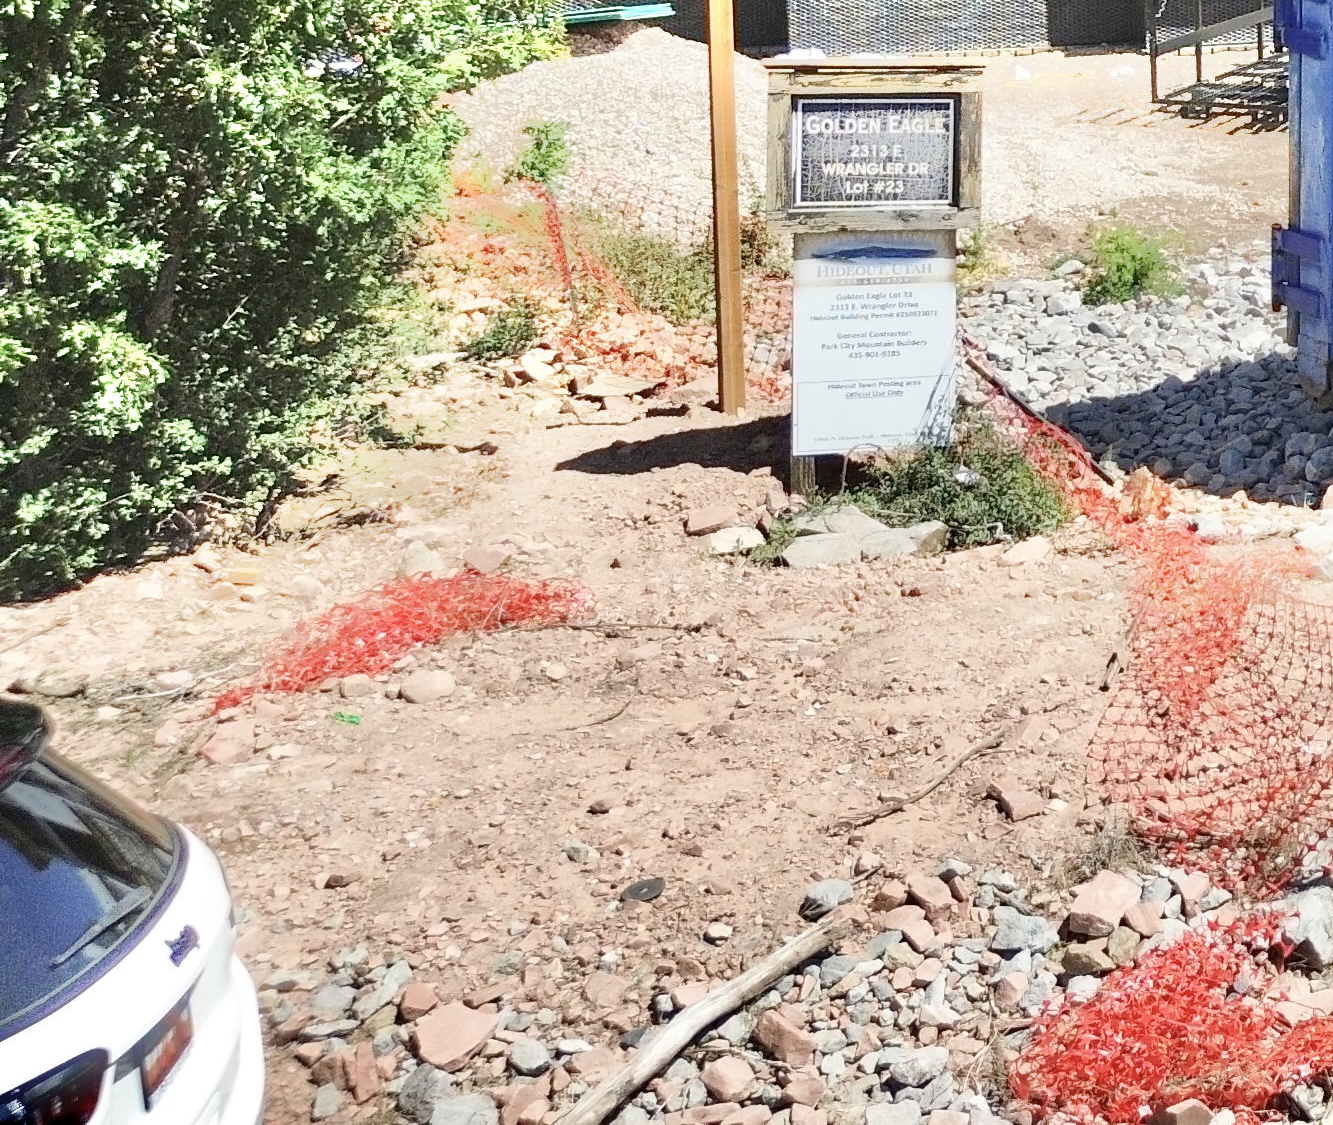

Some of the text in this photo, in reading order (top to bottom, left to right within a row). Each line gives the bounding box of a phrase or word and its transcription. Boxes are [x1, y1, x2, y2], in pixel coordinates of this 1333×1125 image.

[805, 114, 947, 134] GOLDEN EAGLE
[850, 144, 889, 158] 2313
[822, 162, 930, 177] WRANGLER DR
[845, 179, 905, 194] Lot #23
[891, 263, 933, 276] UTAH
[835, 293, 865, 301] Golden
[821, 343, 839, 351] Park
